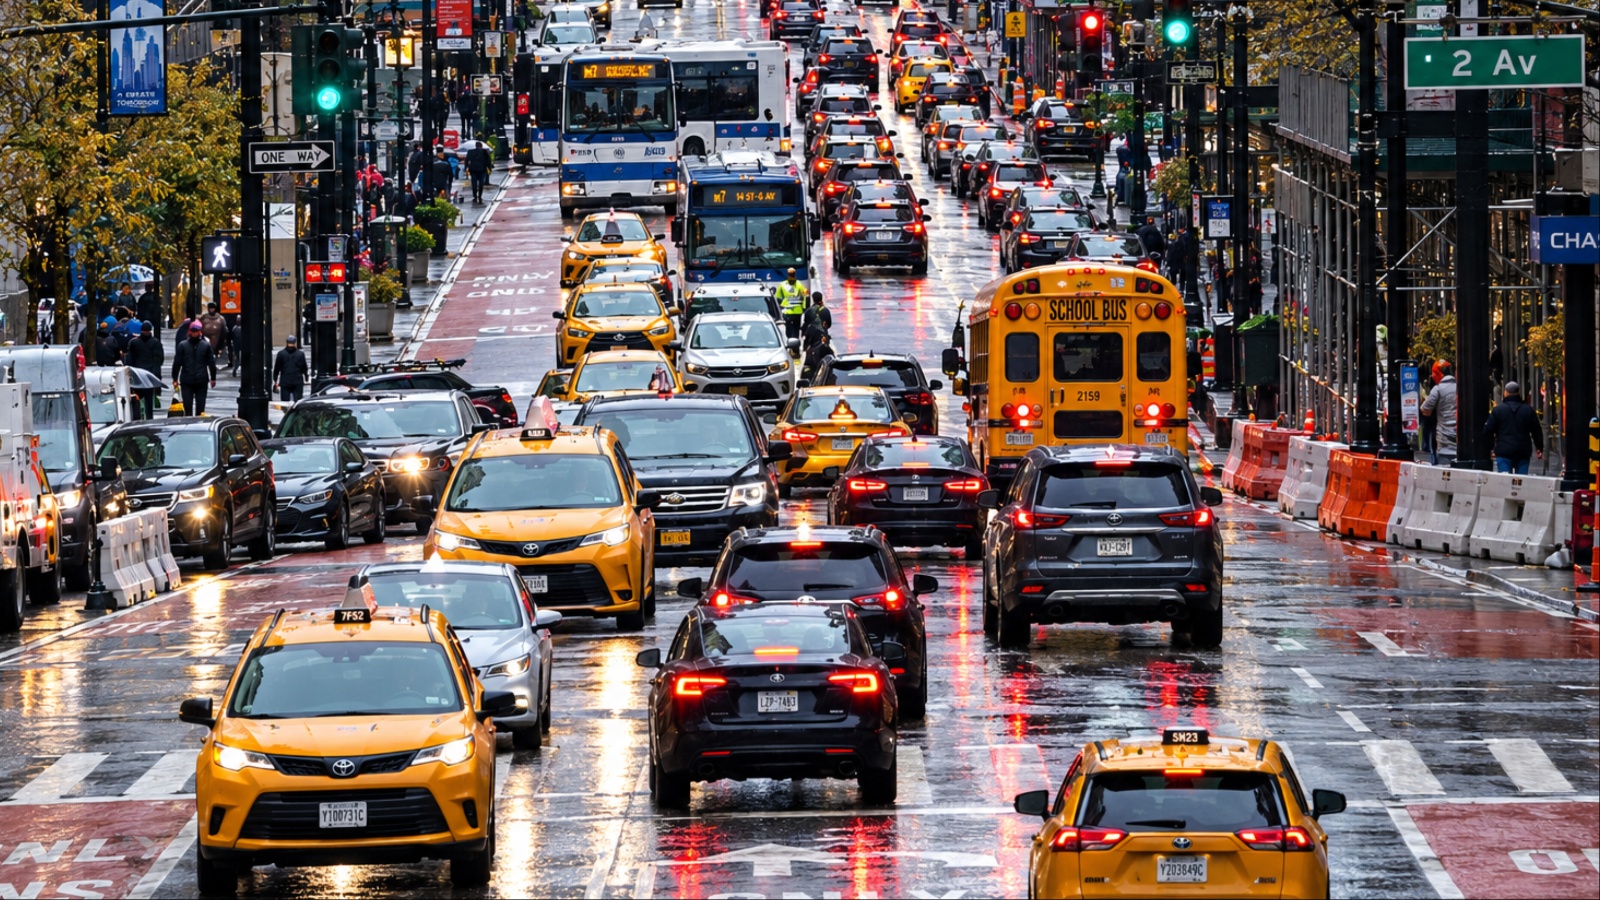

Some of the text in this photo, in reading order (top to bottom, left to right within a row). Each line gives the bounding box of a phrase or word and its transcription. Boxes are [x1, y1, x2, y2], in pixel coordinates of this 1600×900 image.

[1452, 48, 1537, 77] 2 Av
[261, 150, 322, 163] ONE WAY
[1550, 232, 1600, 249] CHA
[1049, 299, 1127, 321] SCHOOL BUS
[322, 809, 364, 823] Y100731C
[0, 836, 160, 865] NLY
[1160, 863, 1204, 877] Y203849C
